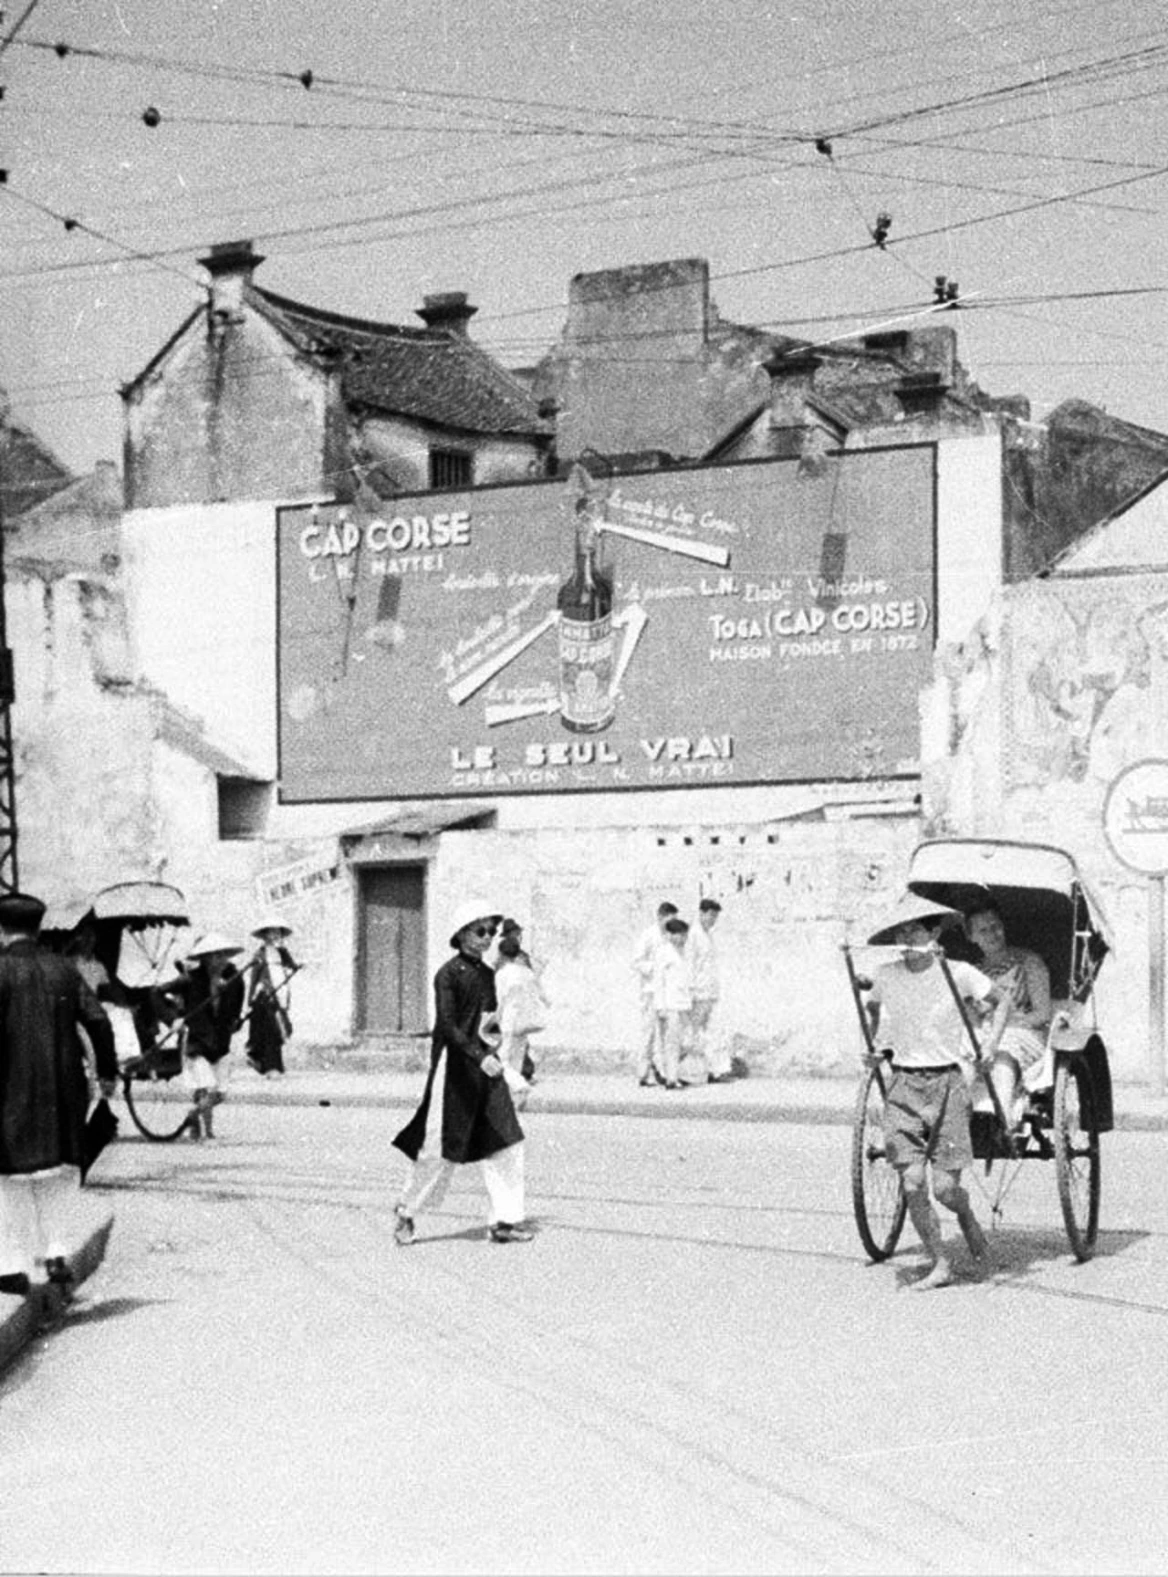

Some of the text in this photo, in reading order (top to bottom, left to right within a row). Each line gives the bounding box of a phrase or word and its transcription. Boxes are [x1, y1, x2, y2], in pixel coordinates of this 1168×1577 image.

[301, 511, 471, 557] CAP CORSE
[370, 554, 443, 576] MATTEI
[766, 606, 826, 637] (CAP
[832, 596, 930, 634] CORSE)
[709, 642, 772, 662] MAISON
[850, 636, 872, 653] EN
[451, 734, 734, 770] LE SEUL VRAI
[649, 762, 734, 781] MATTEI
